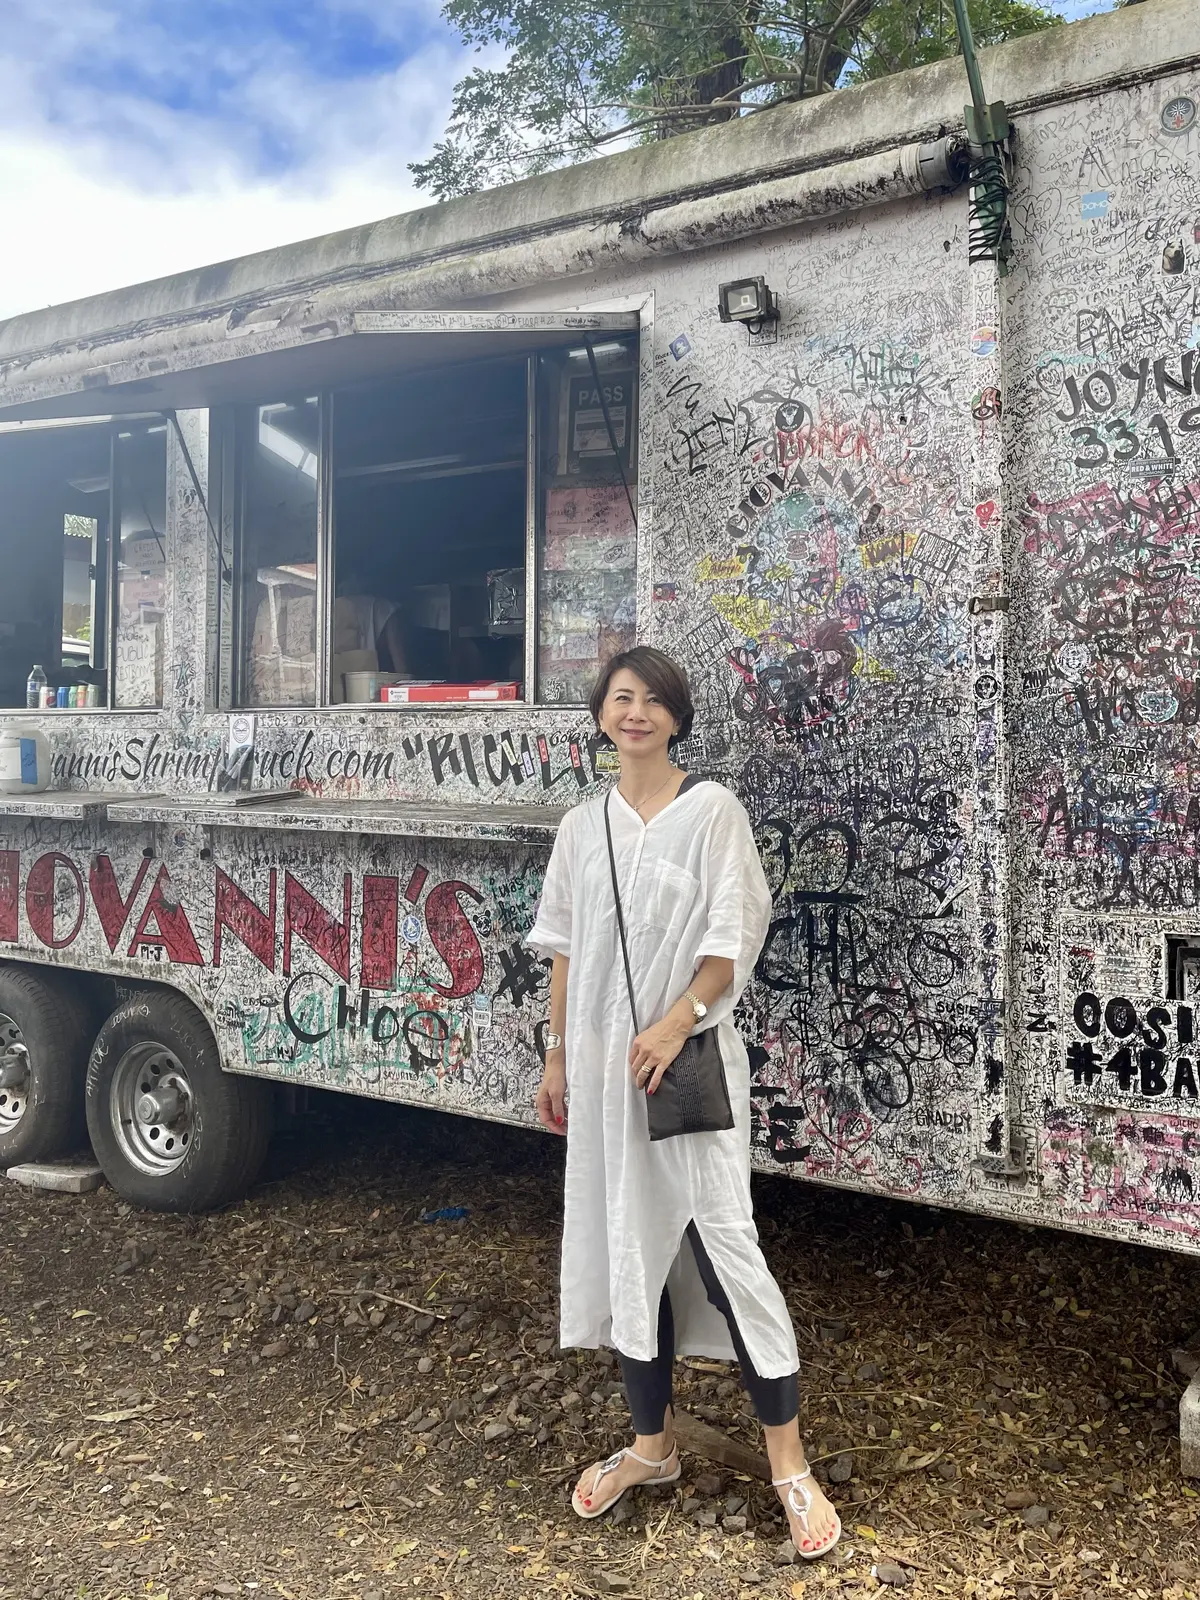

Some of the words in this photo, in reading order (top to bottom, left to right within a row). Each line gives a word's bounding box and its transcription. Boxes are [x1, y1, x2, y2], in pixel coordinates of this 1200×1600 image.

[1082, 200, 1109, 211] DOMO
[578, 385, 624, 406] PASS
[1152, 463, 1173, 471] WHITE
[1066, 1042, 1200, 1097] #4BA
